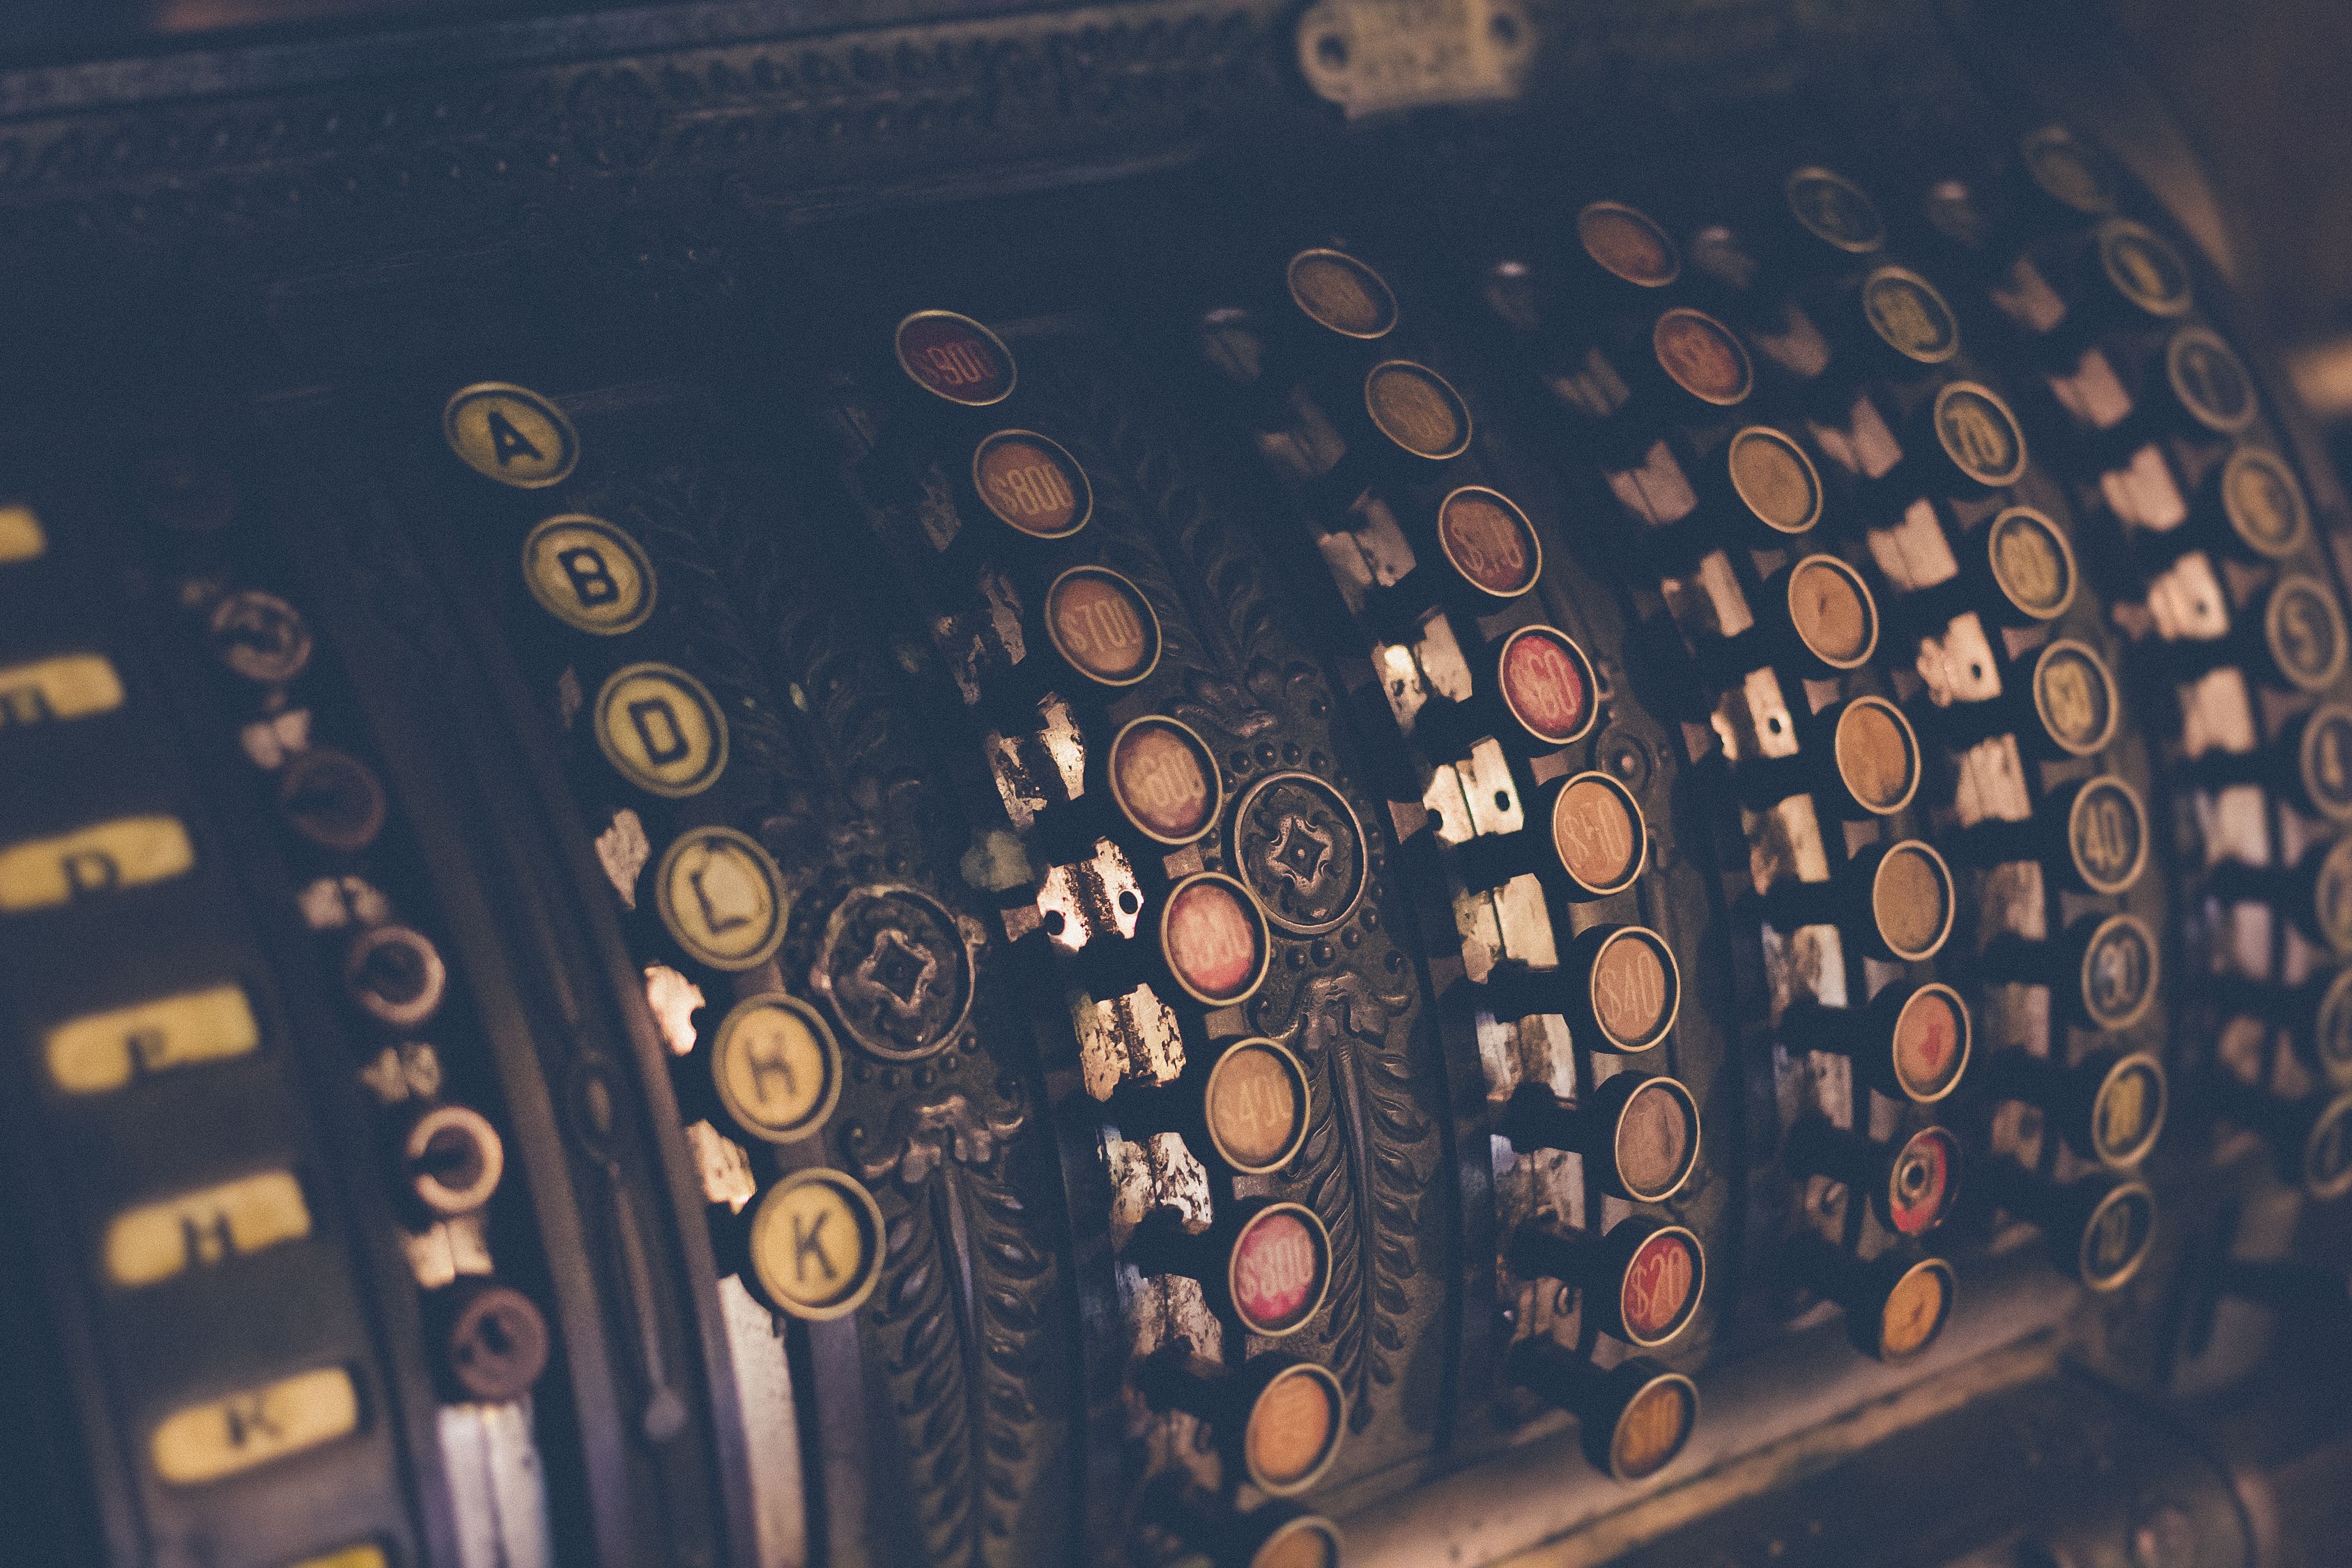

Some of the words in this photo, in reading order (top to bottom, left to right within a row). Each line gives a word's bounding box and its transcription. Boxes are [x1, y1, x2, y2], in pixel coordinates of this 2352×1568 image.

[910, 340, 999, 387] $900
[486, 408, 544, 468] A
[987, 463, 1074, 518] $800
[558, 546, 620, 610] B
[1058, 599, 1139, 654] $700
[628, 698, 689, 767] D
[1599, 951, 1658, 1024] $40
[744, 1031, 797, 1104] H
[790, 1208, 838, 1282] K
[1629, 1245, 1685, 1328] $20
[224, 1392, 282, 1448] K
